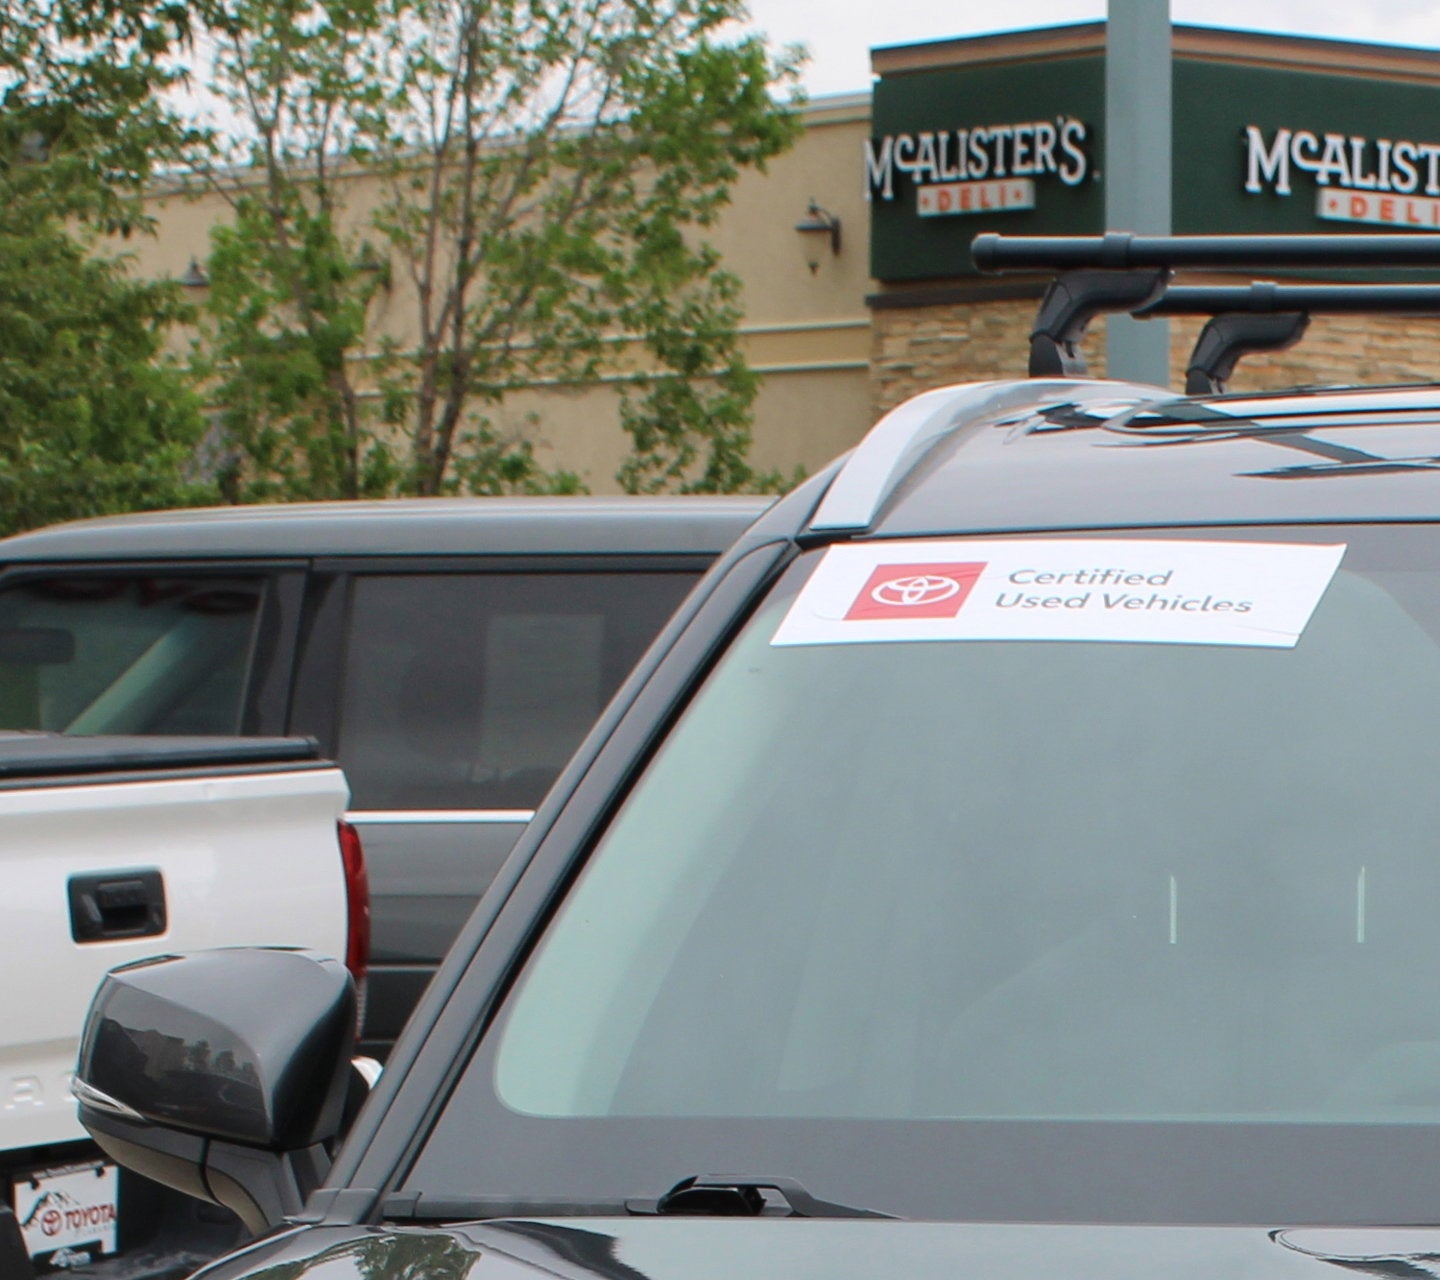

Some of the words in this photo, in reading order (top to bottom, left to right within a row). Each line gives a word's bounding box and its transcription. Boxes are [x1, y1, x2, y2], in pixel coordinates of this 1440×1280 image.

[937, 186, 1008, 211] DELI
[1350, 196, 1440, 223] DELI
[1008, 569, 1174, 587] Certified
[996, 593, 1091, 611] Used
[1103, 593, 1253, 614] Vehicles
[65, 1204, 117, 1230] TOYOTA
